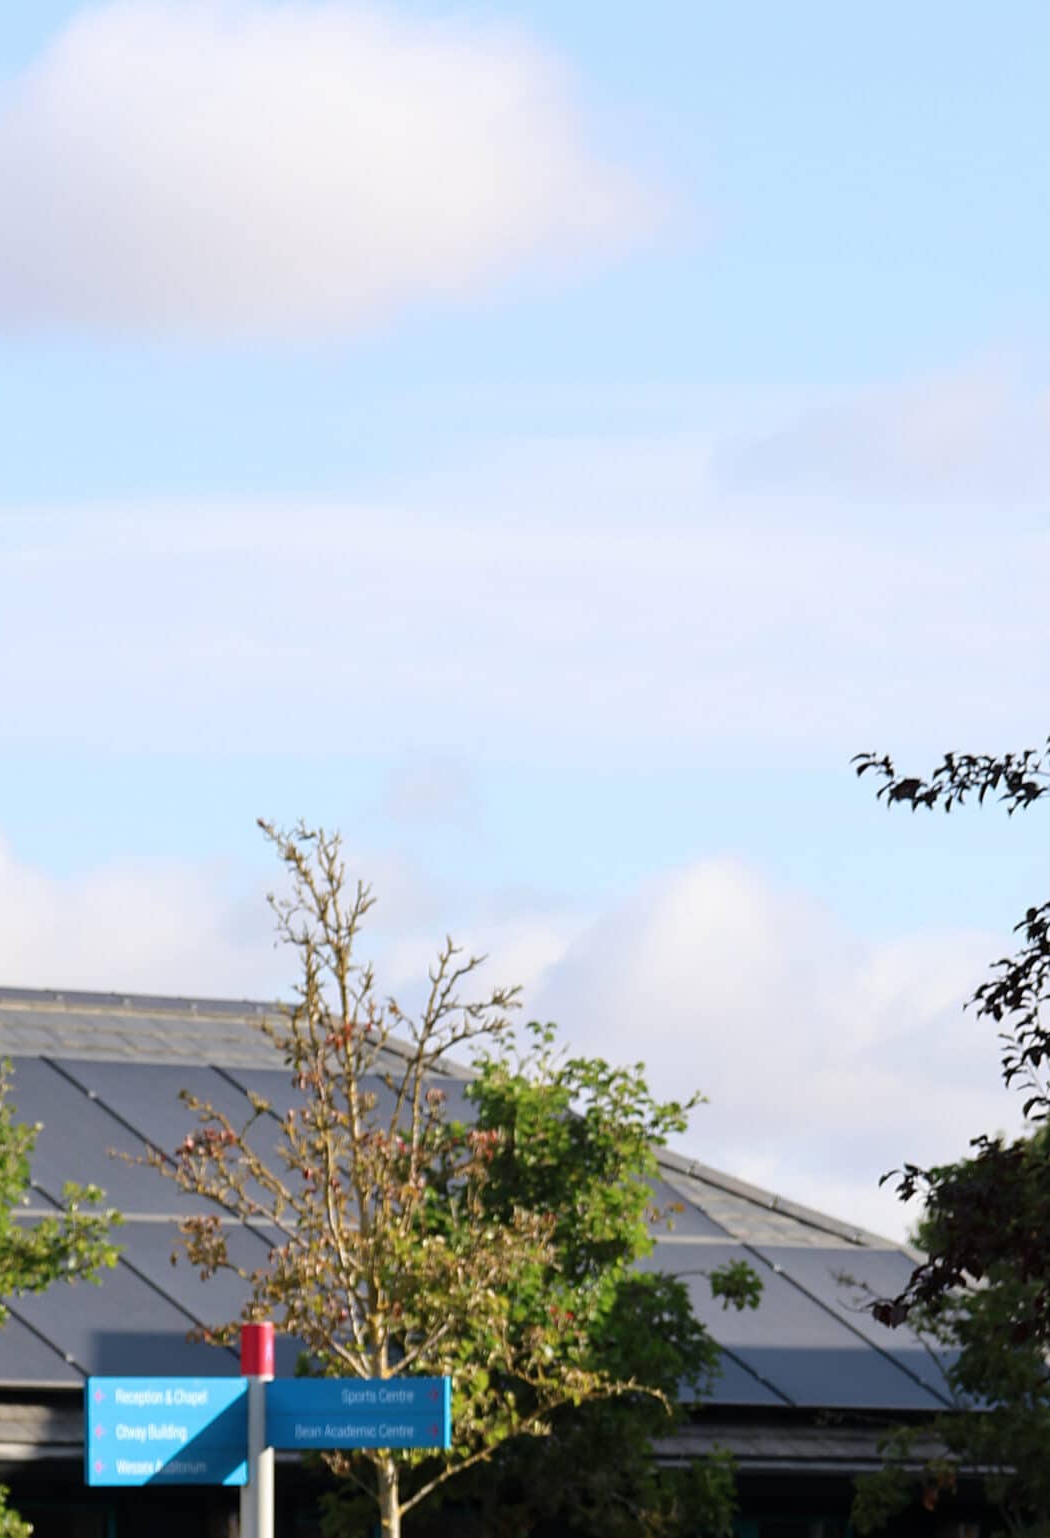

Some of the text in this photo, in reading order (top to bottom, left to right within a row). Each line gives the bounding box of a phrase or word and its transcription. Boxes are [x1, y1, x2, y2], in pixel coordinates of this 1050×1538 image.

[115, 1388, 209, 1407] Reception & Chapel
[341, 1388, 415, 1406] Sports Centre
[148, 1424, 188, 1443] Building
[325, 1423, 376, 1438] Academic
[379, 1423, 415, 1438] Centre
